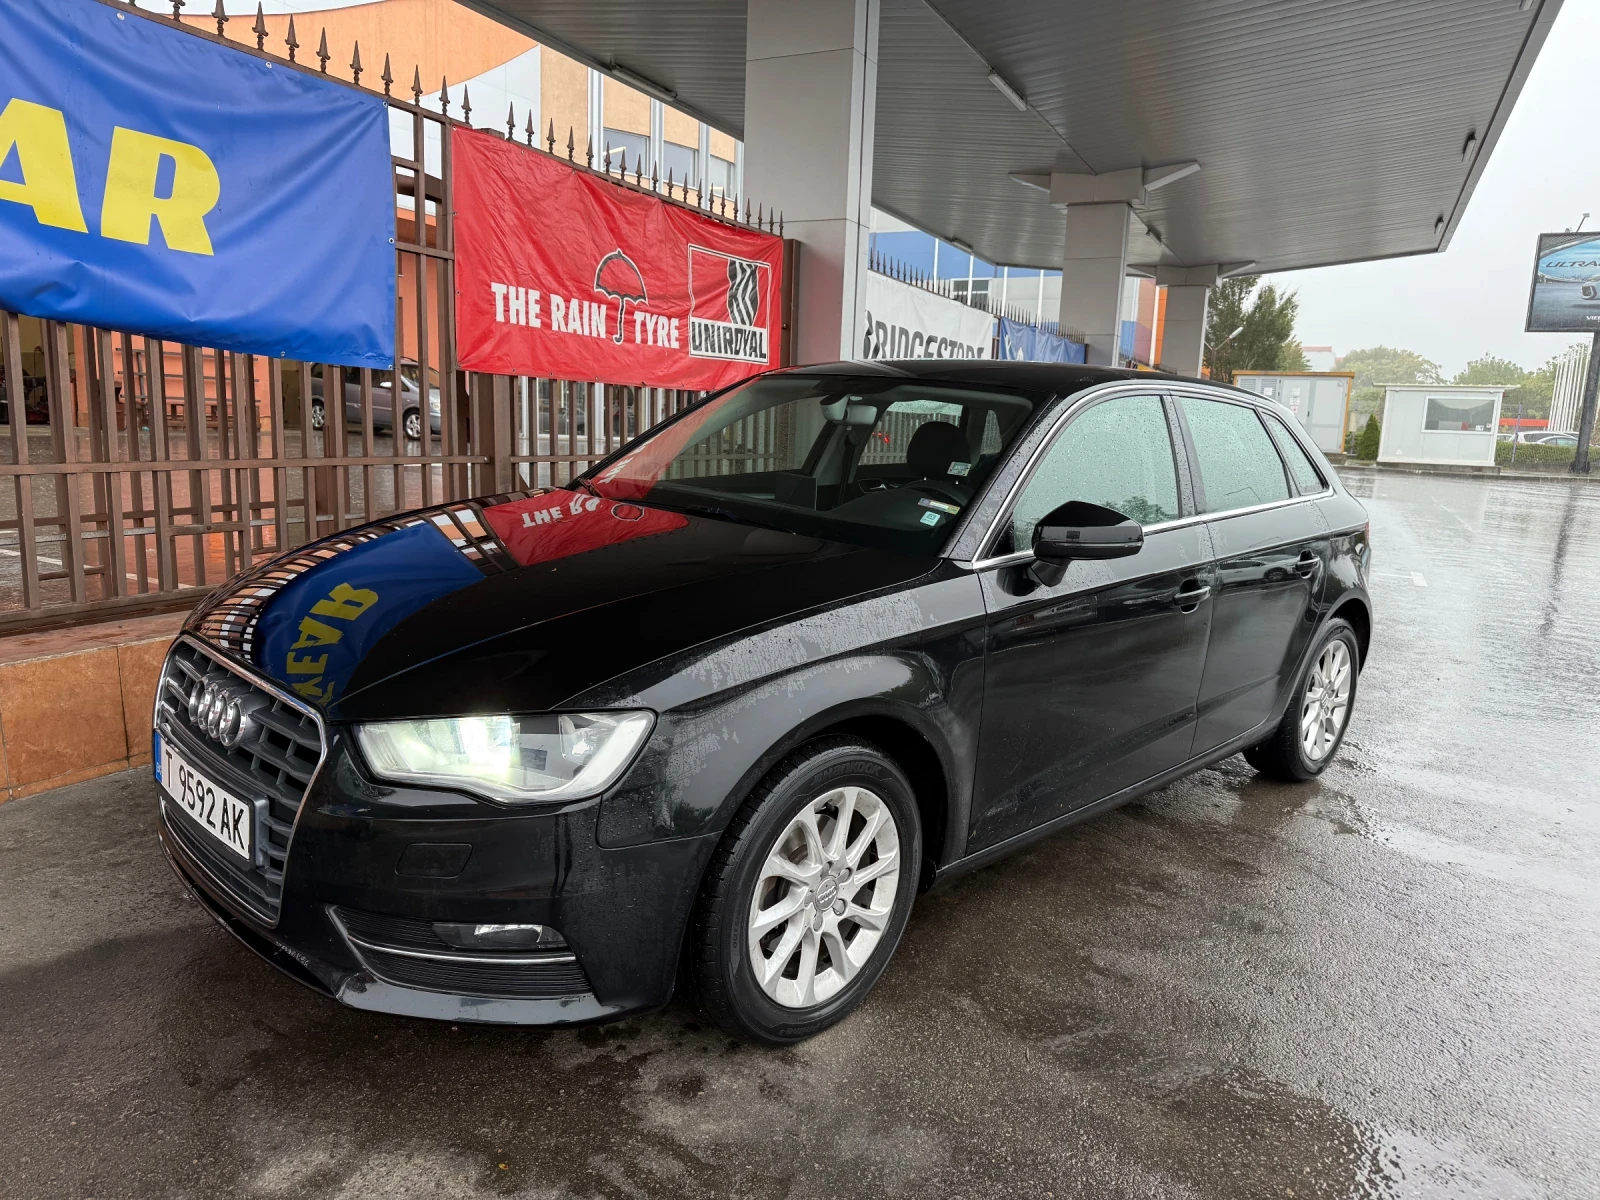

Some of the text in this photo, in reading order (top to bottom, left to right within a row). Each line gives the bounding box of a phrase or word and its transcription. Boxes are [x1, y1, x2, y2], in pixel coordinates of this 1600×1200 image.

[0, 97, 221, 257] AR
[1545, 260, 1600, 268] ULTRA
[490, 281, 680, 350] THE RAIN TYRE
[691, 321, 767, 360] UNIROYAL
[165, 748, 245, 851] T 9592 AK
